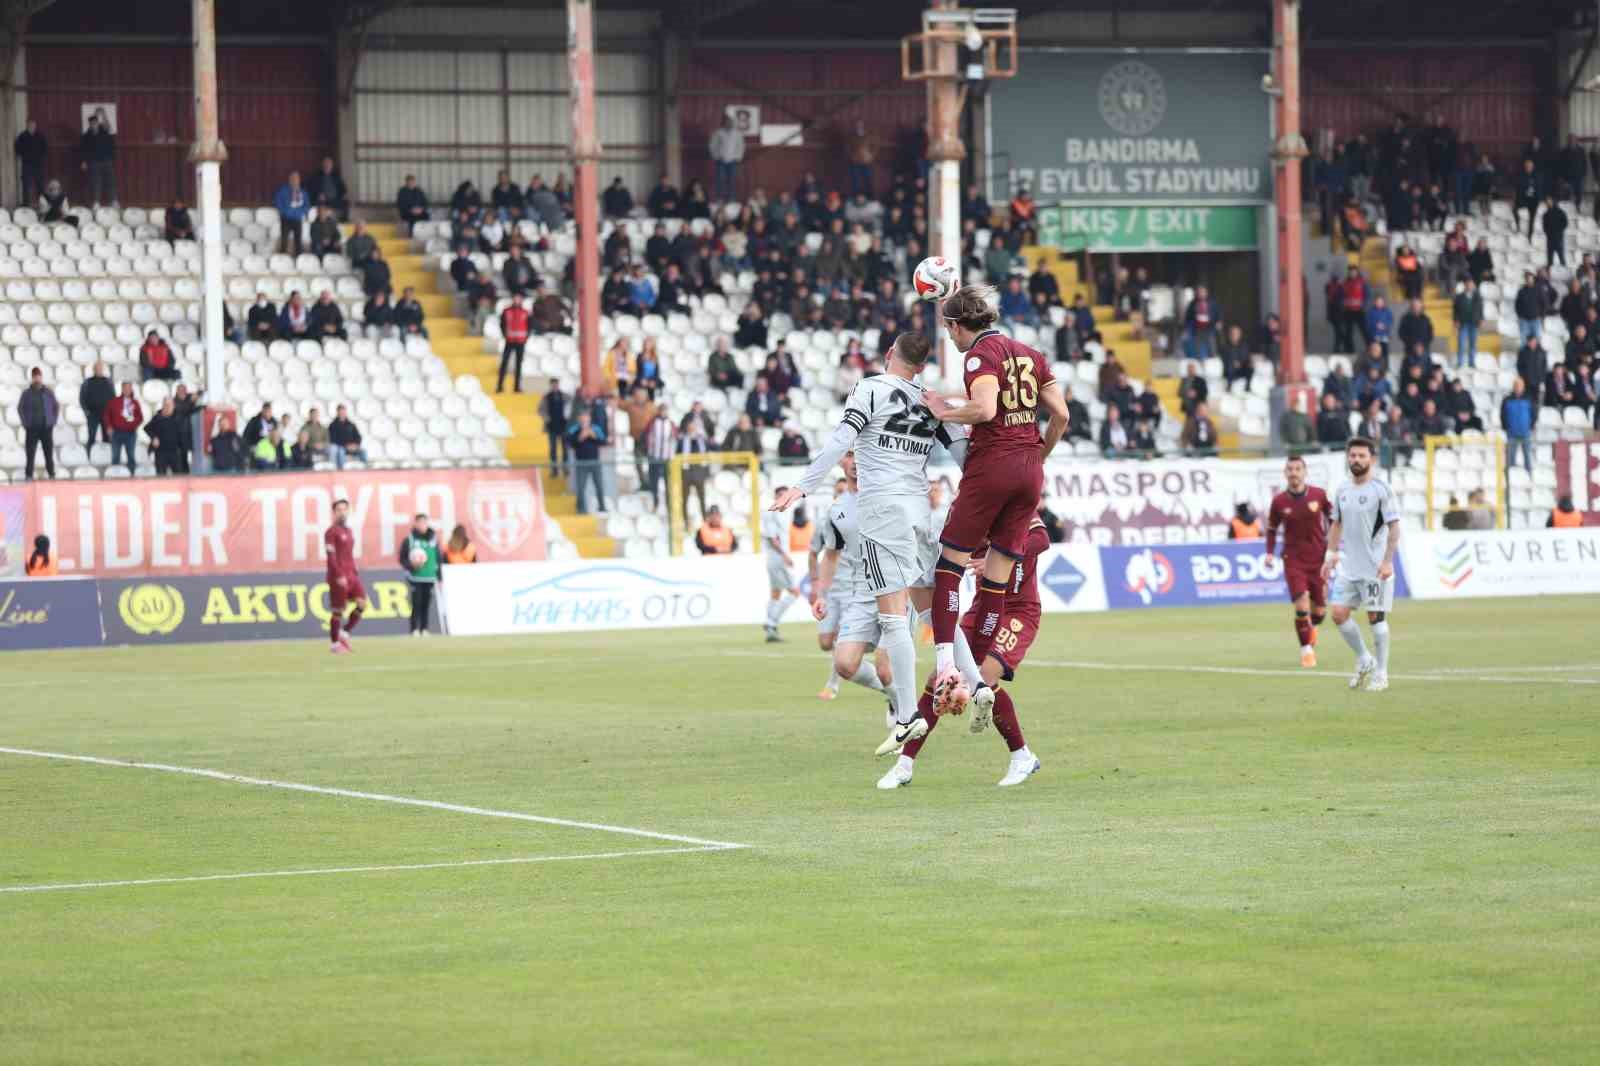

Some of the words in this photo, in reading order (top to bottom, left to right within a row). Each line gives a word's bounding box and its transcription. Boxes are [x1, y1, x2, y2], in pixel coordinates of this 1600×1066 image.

[1066, 138, 1200, 163] BANDIRMA
[1040, 159, 1120, 193] EYLÜL
[1126, 168, 1260, 193] STADYUMU
[1038, 208, 1120, 238] ÇIKIŞ
[1146, 209, 1211, 232] EXIT
[1002, 356, 1038, 409] 33
[883, 388, 936, 438] 22
[1042, 469, 1212, 497] MASPOR
[252, 483, 456, 562] TAYFA
[1474, 538, 1598, 565] EVREN
[1190, 554, 1232, 582] BD
[1367, 583, 1380, 598] 10
[512, 600, 632, 625] KAFKAS
[642, 594, 711, 622] OTO
[996, 627, 1018, 651] 99
